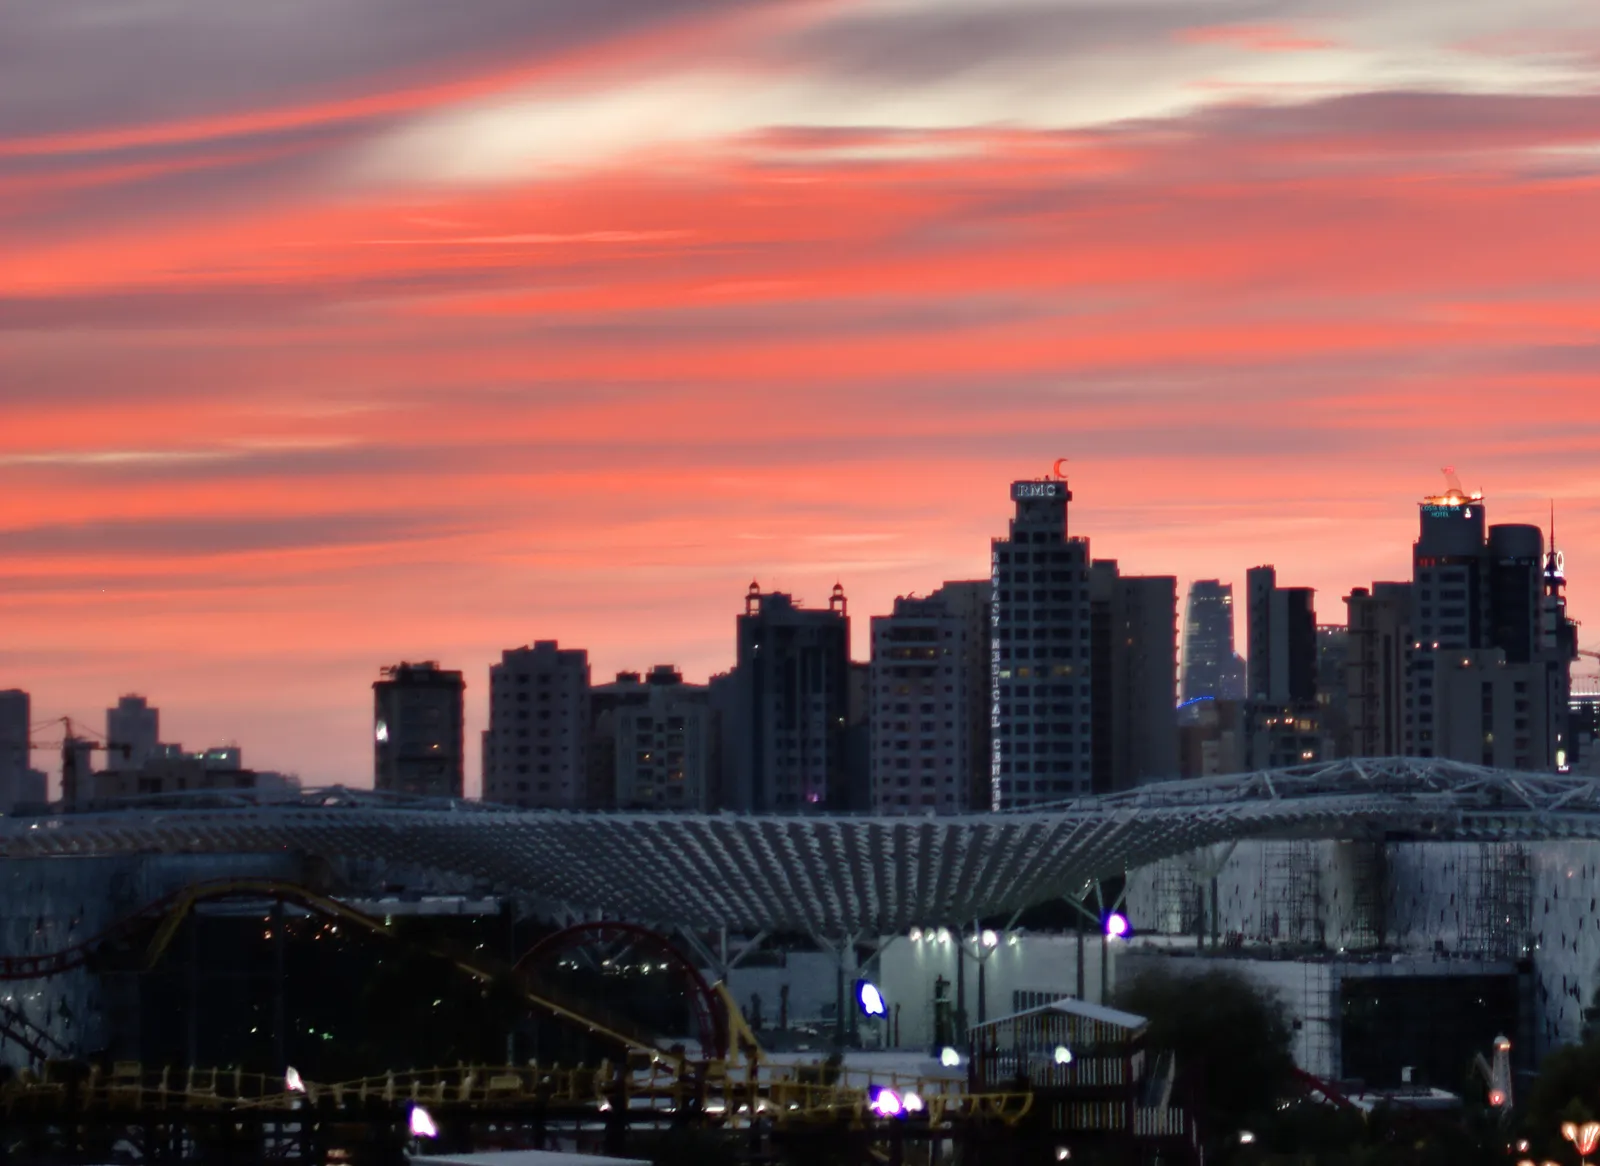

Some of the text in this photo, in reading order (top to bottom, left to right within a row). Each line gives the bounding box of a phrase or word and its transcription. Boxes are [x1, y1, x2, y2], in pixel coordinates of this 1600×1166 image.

[1017, 484, 1056, 497] RMC
[991, 638, 1001, 728] MEDICAL
[991, 738, 1001, 812] CENTER
